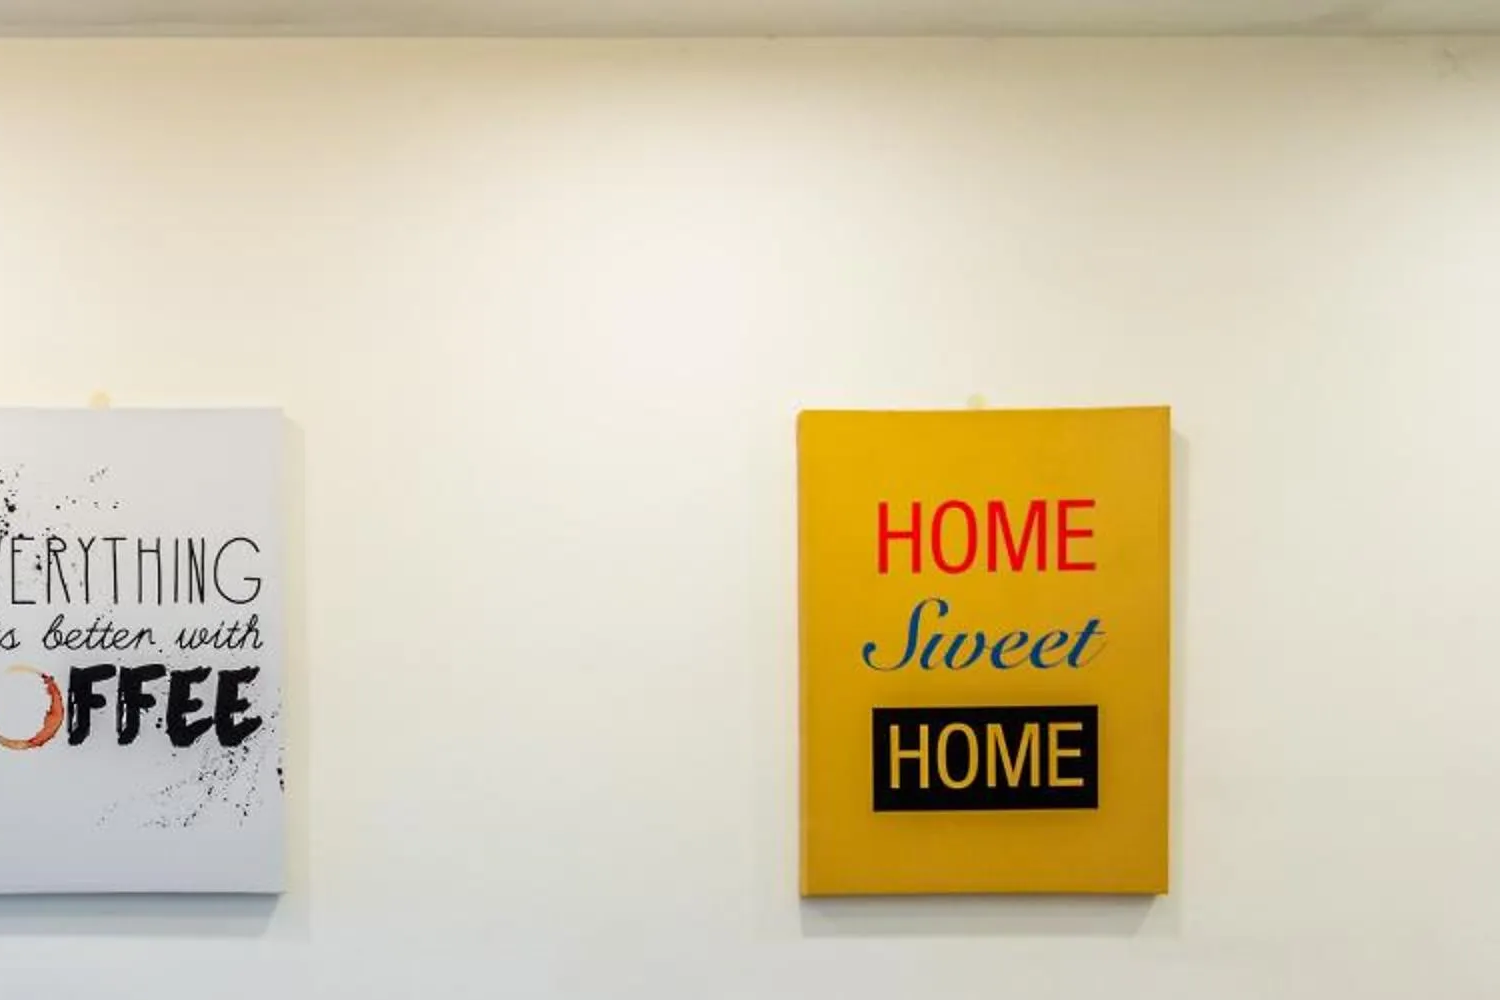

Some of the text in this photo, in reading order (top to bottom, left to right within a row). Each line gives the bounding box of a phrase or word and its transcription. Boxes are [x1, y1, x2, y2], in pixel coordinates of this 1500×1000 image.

[877, 499, 1097, 574] HOME
[42, 614, 156, 651] better
[176, 614, 263, 651] with
[862, 597, 1107, 671] Sweet
[889, 722, 1084, 789] HOME
